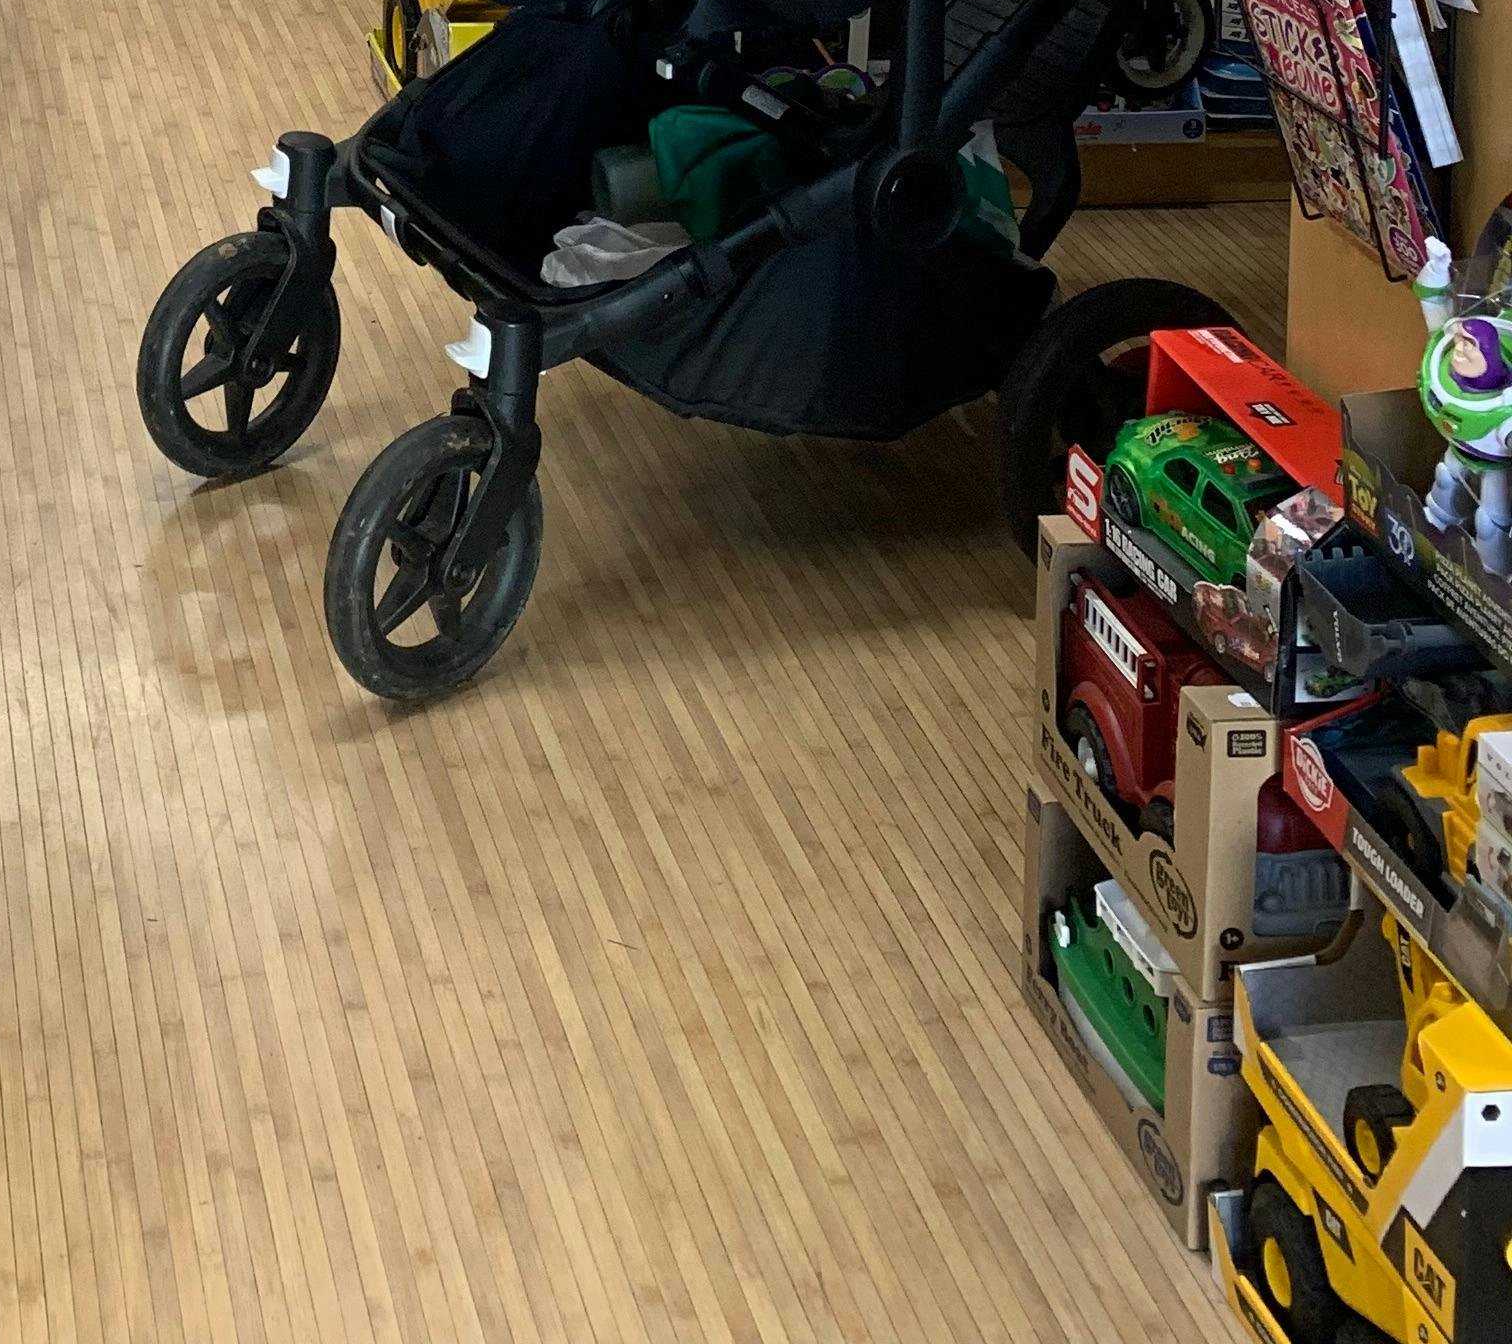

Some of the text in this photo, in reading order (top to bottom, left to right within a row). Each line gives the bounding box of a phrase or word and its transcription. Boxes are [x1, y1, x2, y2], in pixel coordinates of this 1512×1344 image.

[1351, 827, 1425, 919] TOUGH LOADER
[1413, 1249, 1448, 1313] CAT
